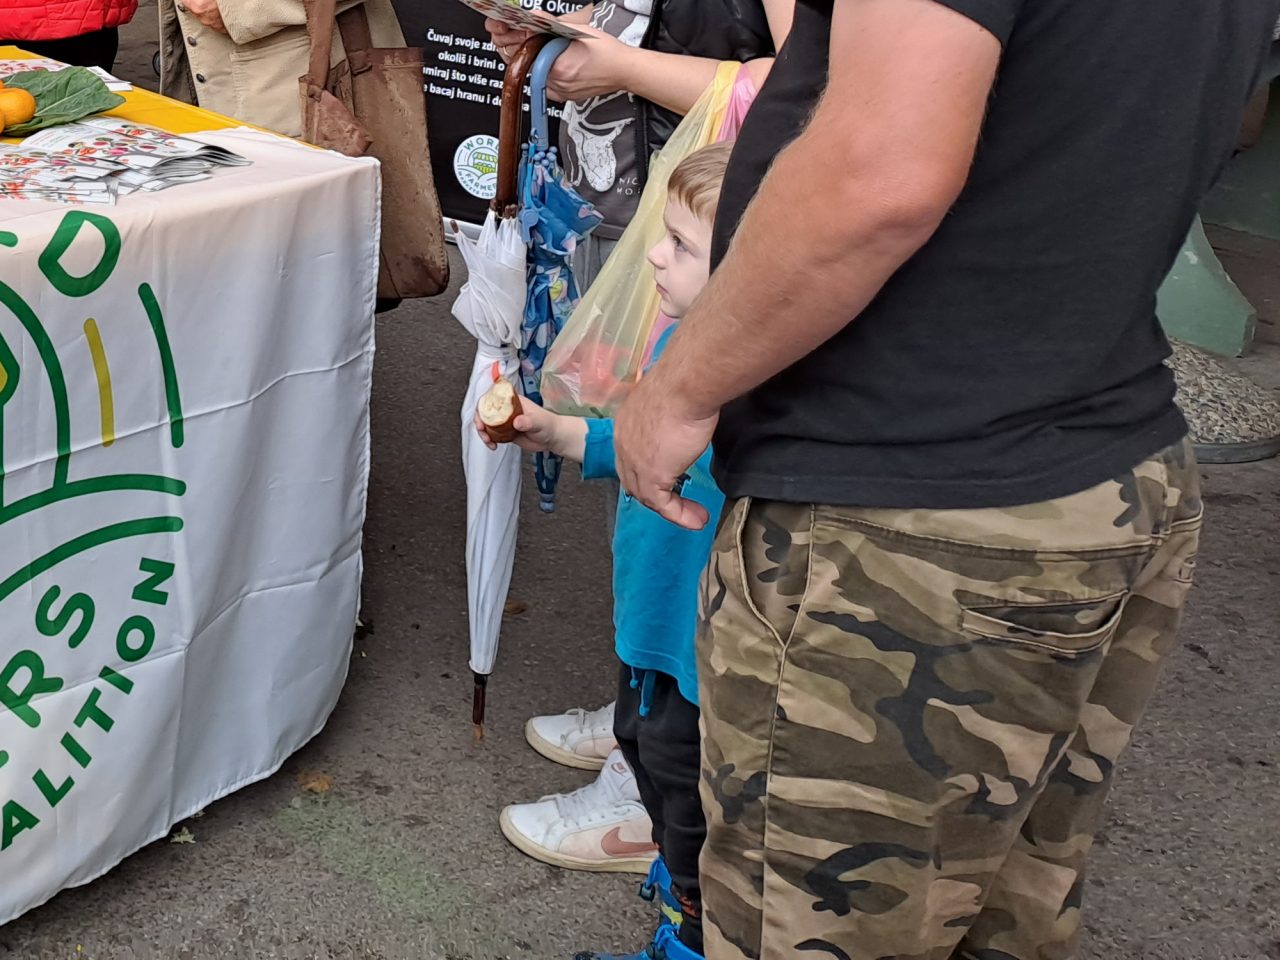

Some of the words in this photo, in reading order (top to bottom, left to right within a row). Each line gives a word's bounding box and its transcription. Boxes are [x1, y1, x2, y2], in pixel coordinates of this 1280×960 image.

[427, 29, 453, 46] Čuvaj
[455, 36, 480, 50] svoje
[438, 51, 466, 65] okoliš
[473, 55, 496, 69] brini
[451, 68, 466, 81] što
[469, 73, 487, 86] više
[430, 83, 455, 99] bacaj
[456, 89, 485, 103] hranu
